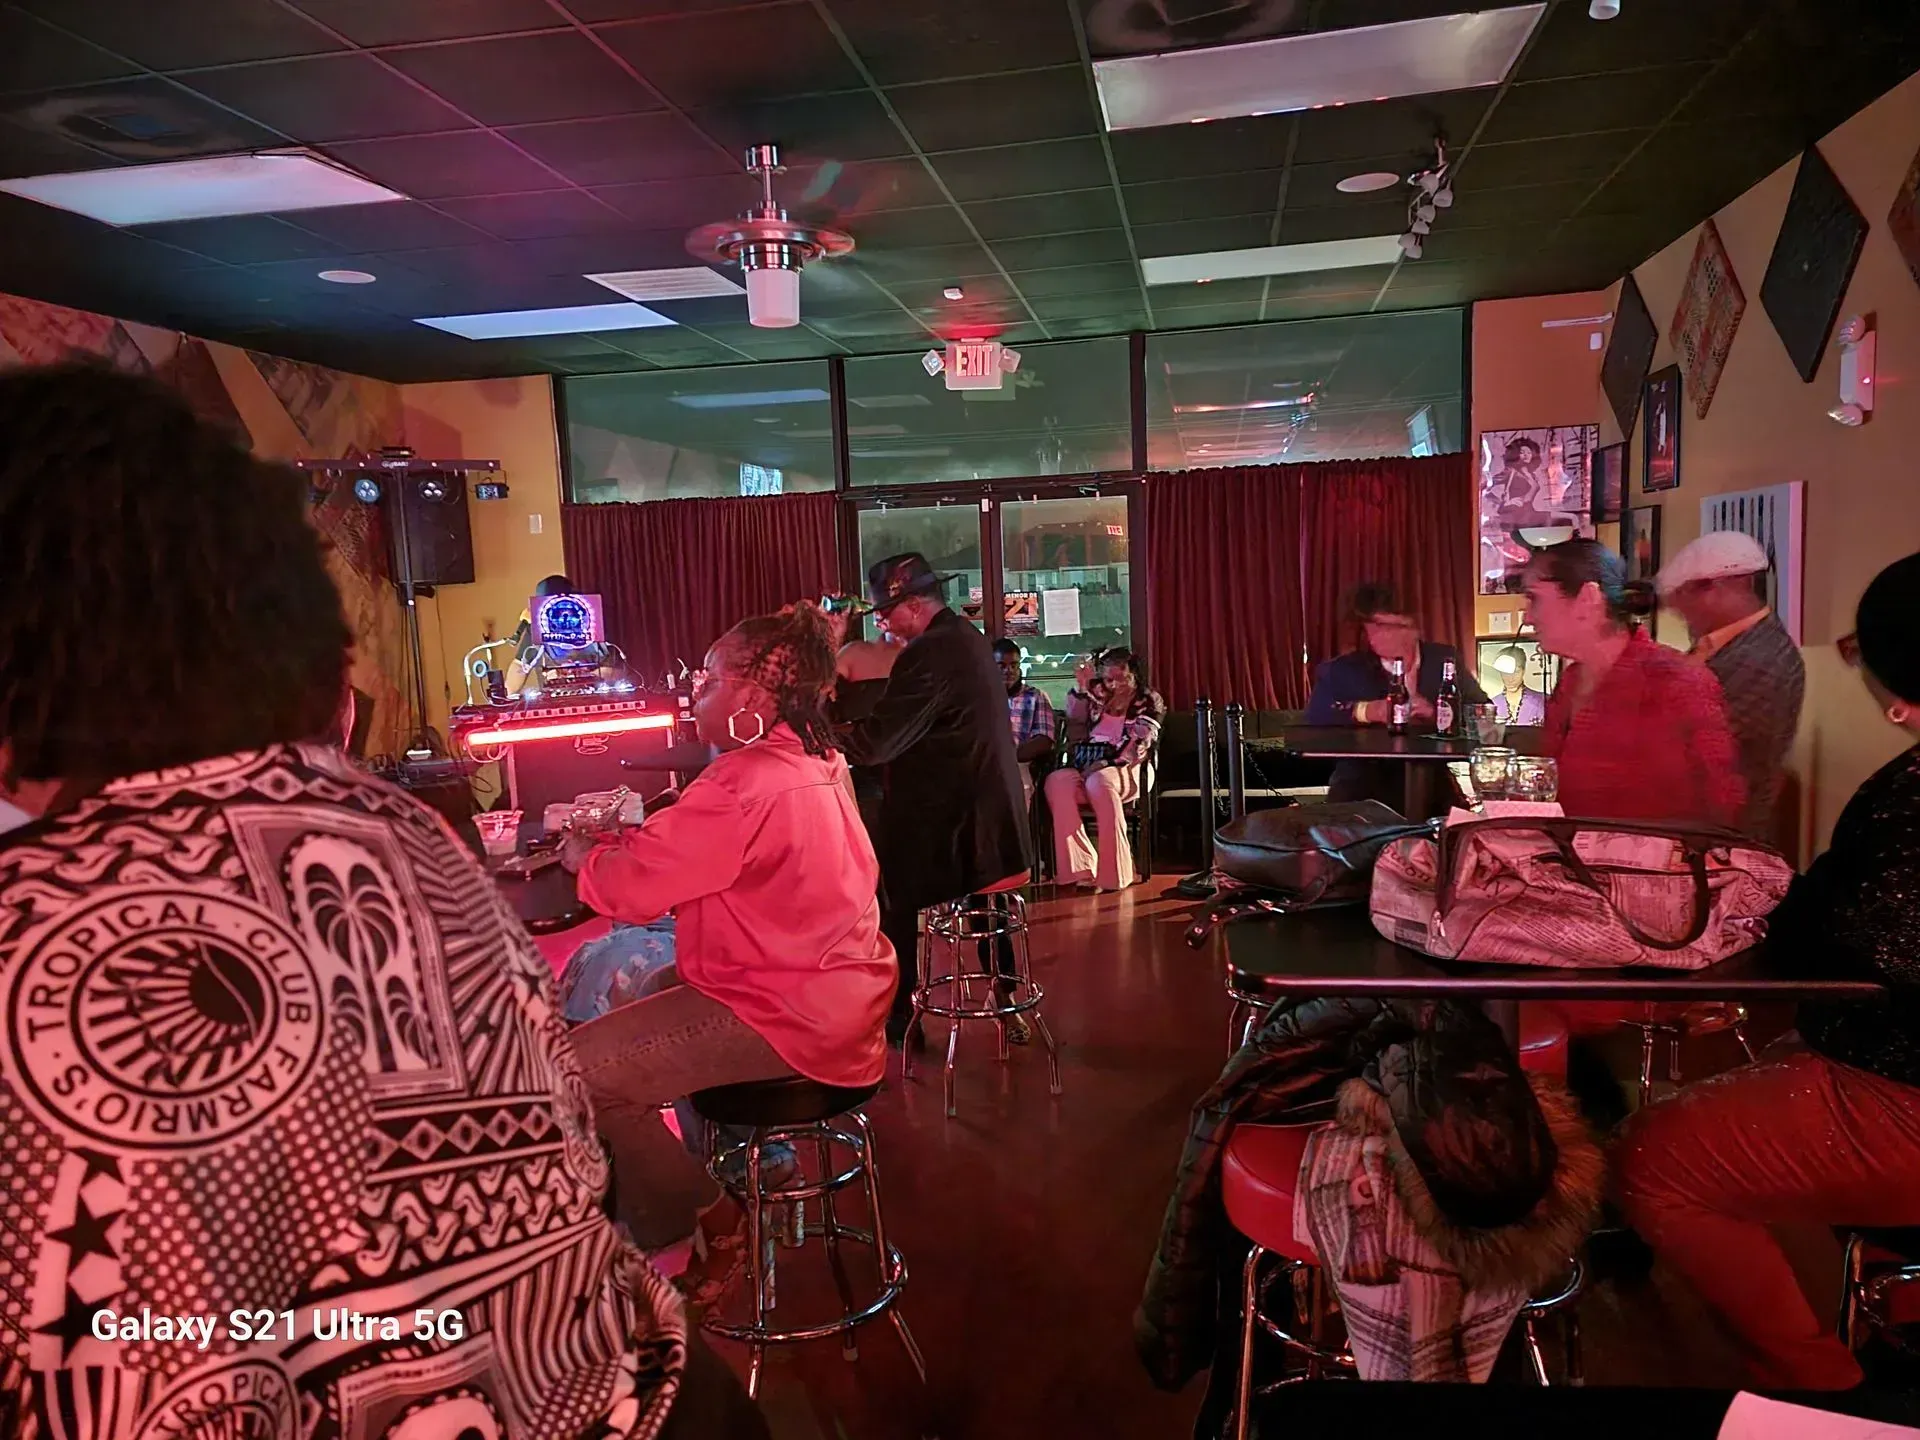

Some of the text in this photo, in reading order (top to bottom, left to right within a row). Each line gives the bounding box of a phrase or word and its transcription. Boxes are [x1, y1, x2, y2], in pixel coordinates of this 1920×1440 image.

[956, 345, 993, 377] EXIT
[1004, 598, 1039, 618] 21
[28, 901, 312, 1134] TROPICAL CLUB FARMRIO'S
